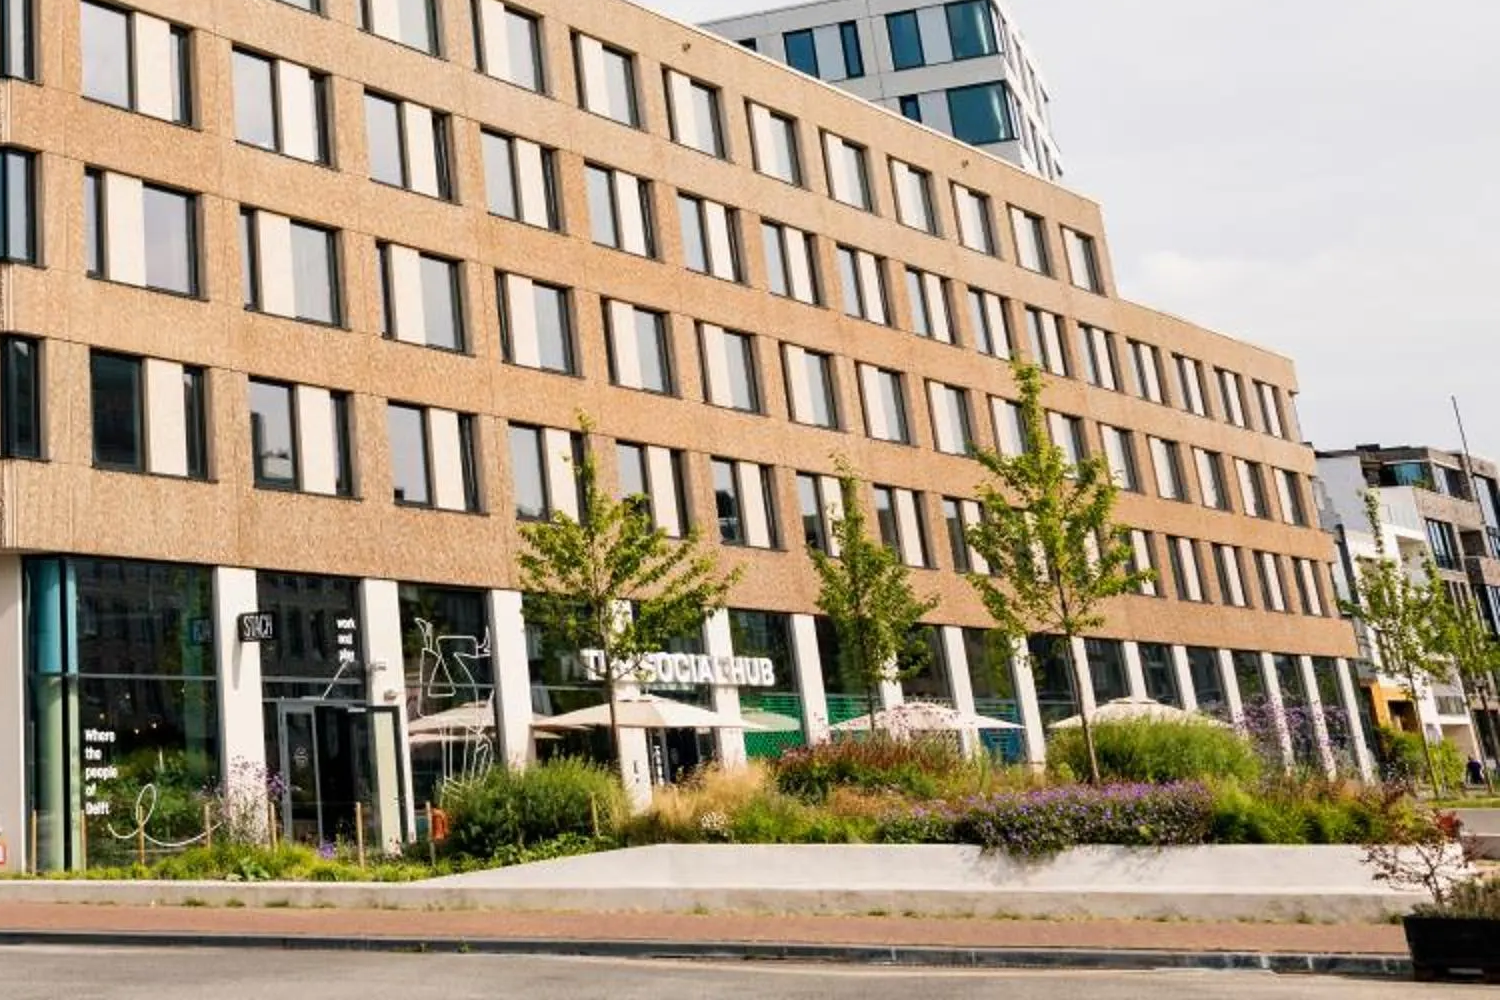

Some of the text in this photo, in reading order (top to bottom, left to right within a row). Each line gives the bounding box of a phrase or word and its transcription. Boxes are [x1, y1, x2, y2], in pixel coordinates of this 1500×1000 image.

[243, 615, 273, 638] STACH
[336, 617, 356, 629] work
[731, 656, 775, 686] HUB
[85, 728, 116, 742] Where
[85, 746, 102, 760] the
[85, 766, 118, 780] people
[85, 783, 96, 796] of
